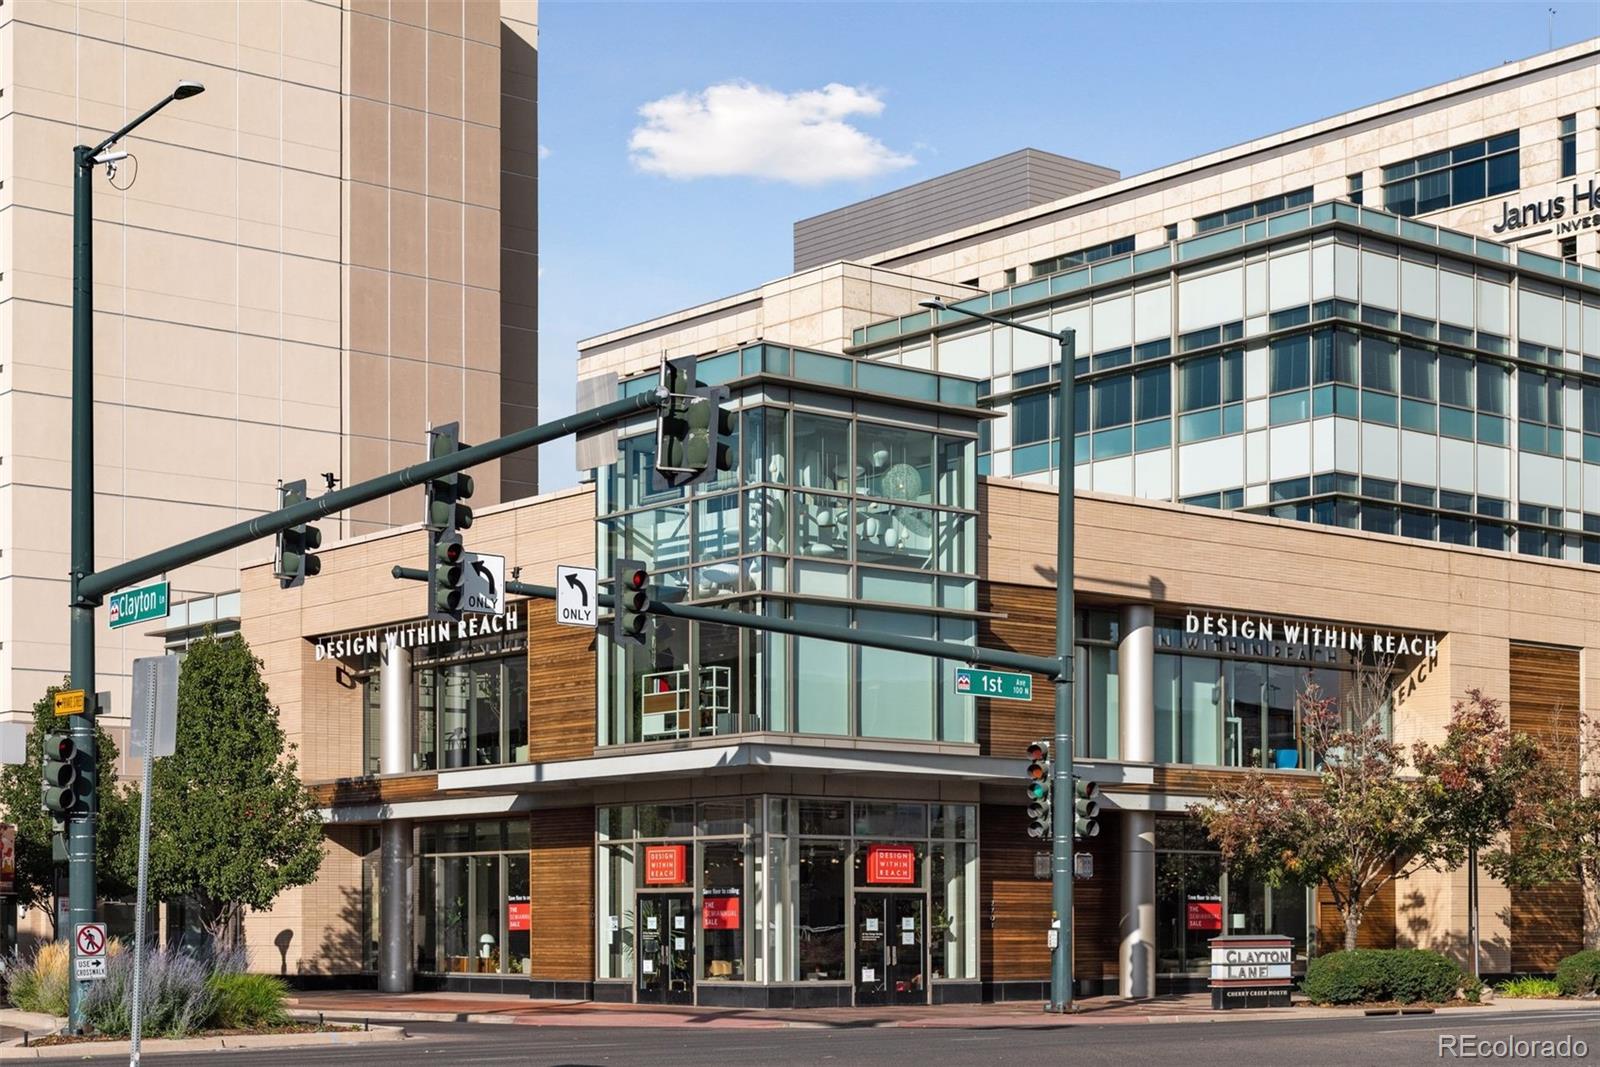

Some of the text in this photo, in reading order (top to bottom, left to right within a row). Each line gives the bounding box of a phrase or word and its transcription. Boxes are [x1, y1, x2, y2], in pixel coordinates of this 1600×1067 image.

[1493, 196, 1565, 233] Janus
[119, 591, 157, 620] Clayton
[468, 595, 498, 609] ONLY
[562, 607, 592, 621] ONLY
[315, 610, 518, 662] DESIGN WITHIN REACH
[1186, 614, 1437, 658] DESIGN WITHIN REACH
[982, 675, 1003, 693] 1st
[1015, 679, 1026, 687] Ave
[1013, 687, 1023, 695] 100
[1226, 950, 1289, 964] CLAYTON
[1227, 965, 1267, 978] LANE
